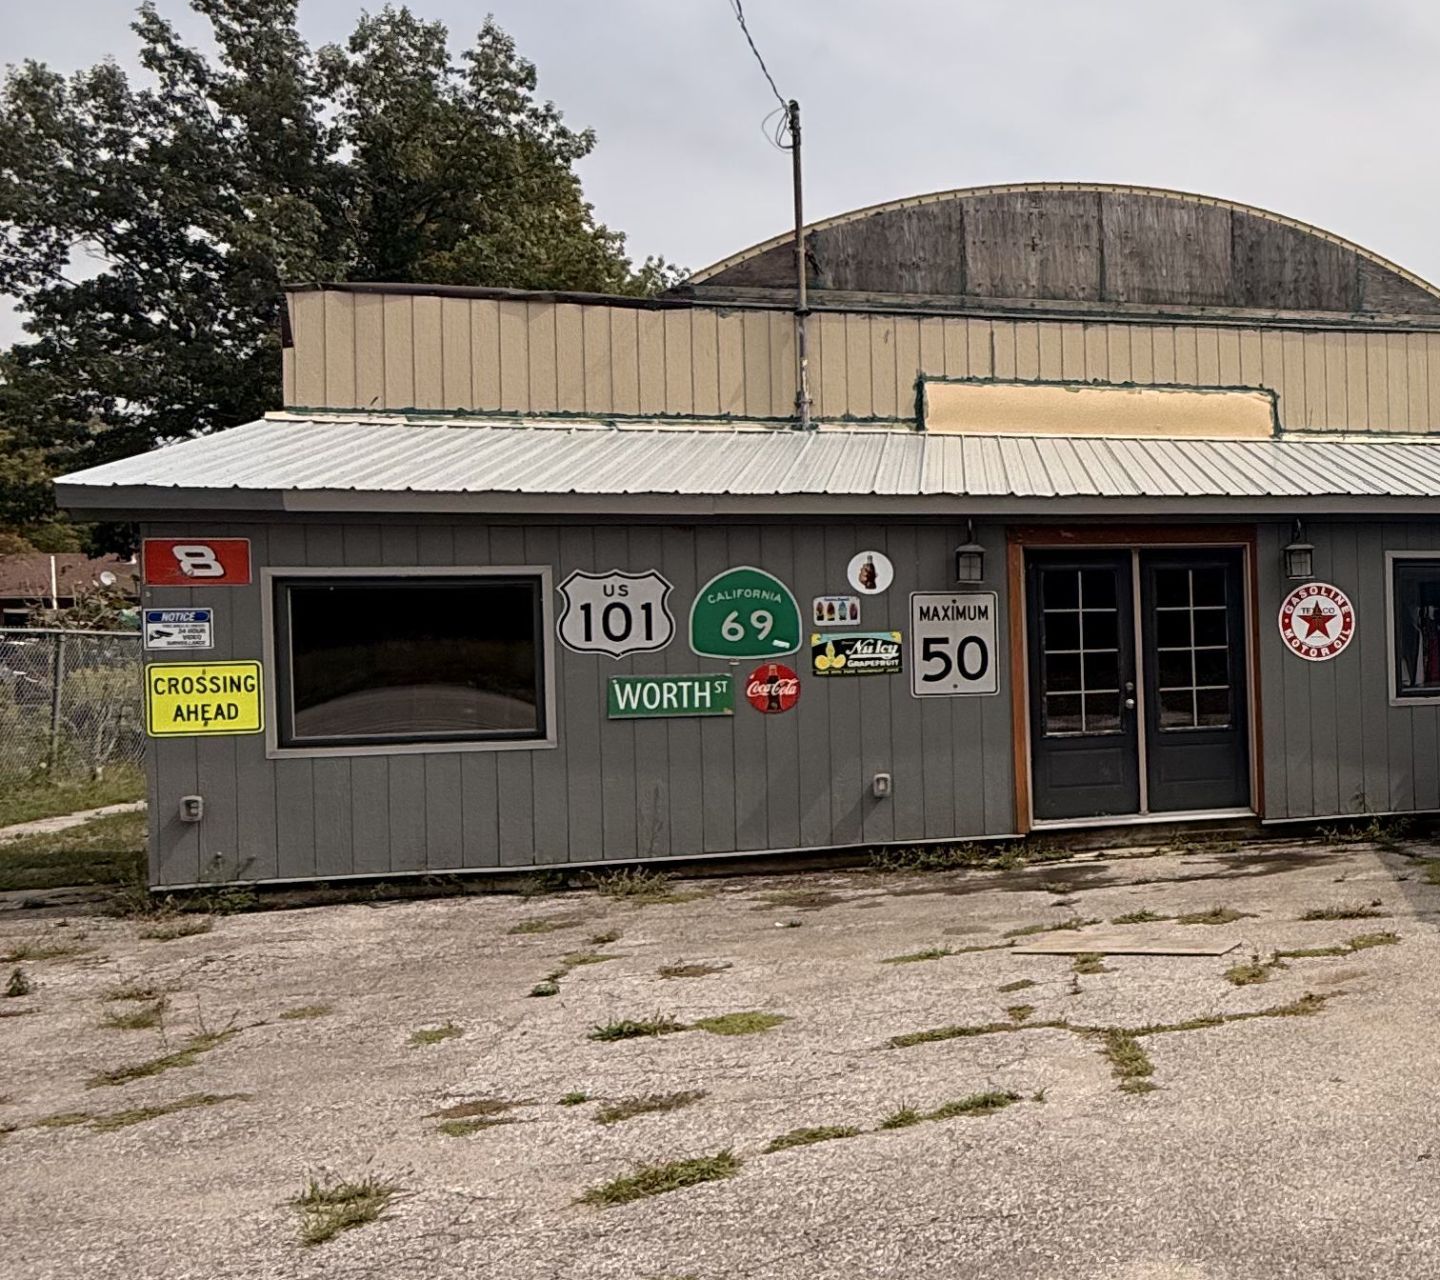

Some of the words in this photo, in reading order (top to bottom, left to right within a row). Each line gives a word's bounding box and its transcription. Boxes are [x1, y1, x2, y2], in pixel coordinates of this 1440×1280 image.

[172, 545, 225, 577] 8
[603, 584, 629, 597] US
[707, 588, 782, 604] CALIFORNIA
[1284, 586, 1351, 615] GASOLINE
[160, 611, 197, 622] NOTICE
[579, 601, 653, 642] 101
[919, 604, 989, 622] MAXIMUM
[721, 610, 774, 642] 69
[1284, 628, 1330, 657] MOTOR
[1333, 629, 1351, 649] OIL
[847, 659, 900, 668] GRAPEFRUIT
[921, 634, 989, 683] 50
[153, 675, 256, 695] CROSSING
[615, 680, 712, 711] WORTH
[714, 680, 728, 693] ST
[173, 702, 239, 722] AHEAD
